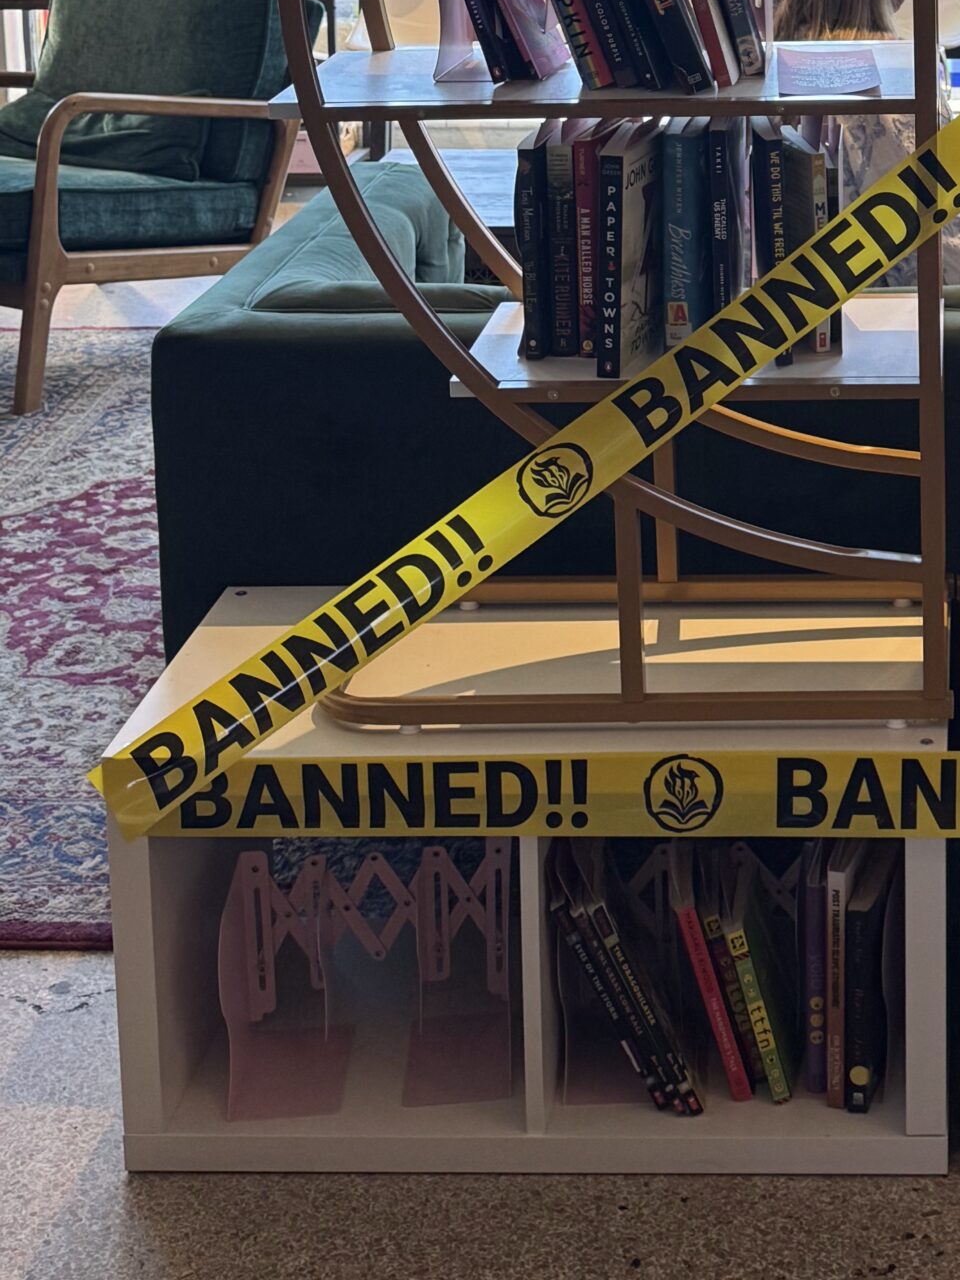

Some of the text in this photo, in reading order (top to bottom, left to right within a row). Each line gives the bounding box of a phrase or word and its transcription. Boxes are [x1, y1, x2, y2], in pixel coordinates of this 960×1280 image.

[593, 1, 610, 31] COLOR
[604, 31, 622, 63] PURPLE
[580, 216, 590, 235] MAN
[713, 201, 720, 211] US
[768, 151, 784, 258] WE DO THIS 'TIL WE FREE
[581, 238, 592, 273] CALLED
[602, 185, 617, 349] PAPER TOWNS
[668, 222, 694, 300] Breathless
[553, 254, 570, 335] KITE RUNNER
[582, 275, 592, 305] HORSE
[129, 515, 494, 812] BANNED!!
[180, 760, 591, 831] BANNED!!
[748, 1004, 775, 1050] ttfn
